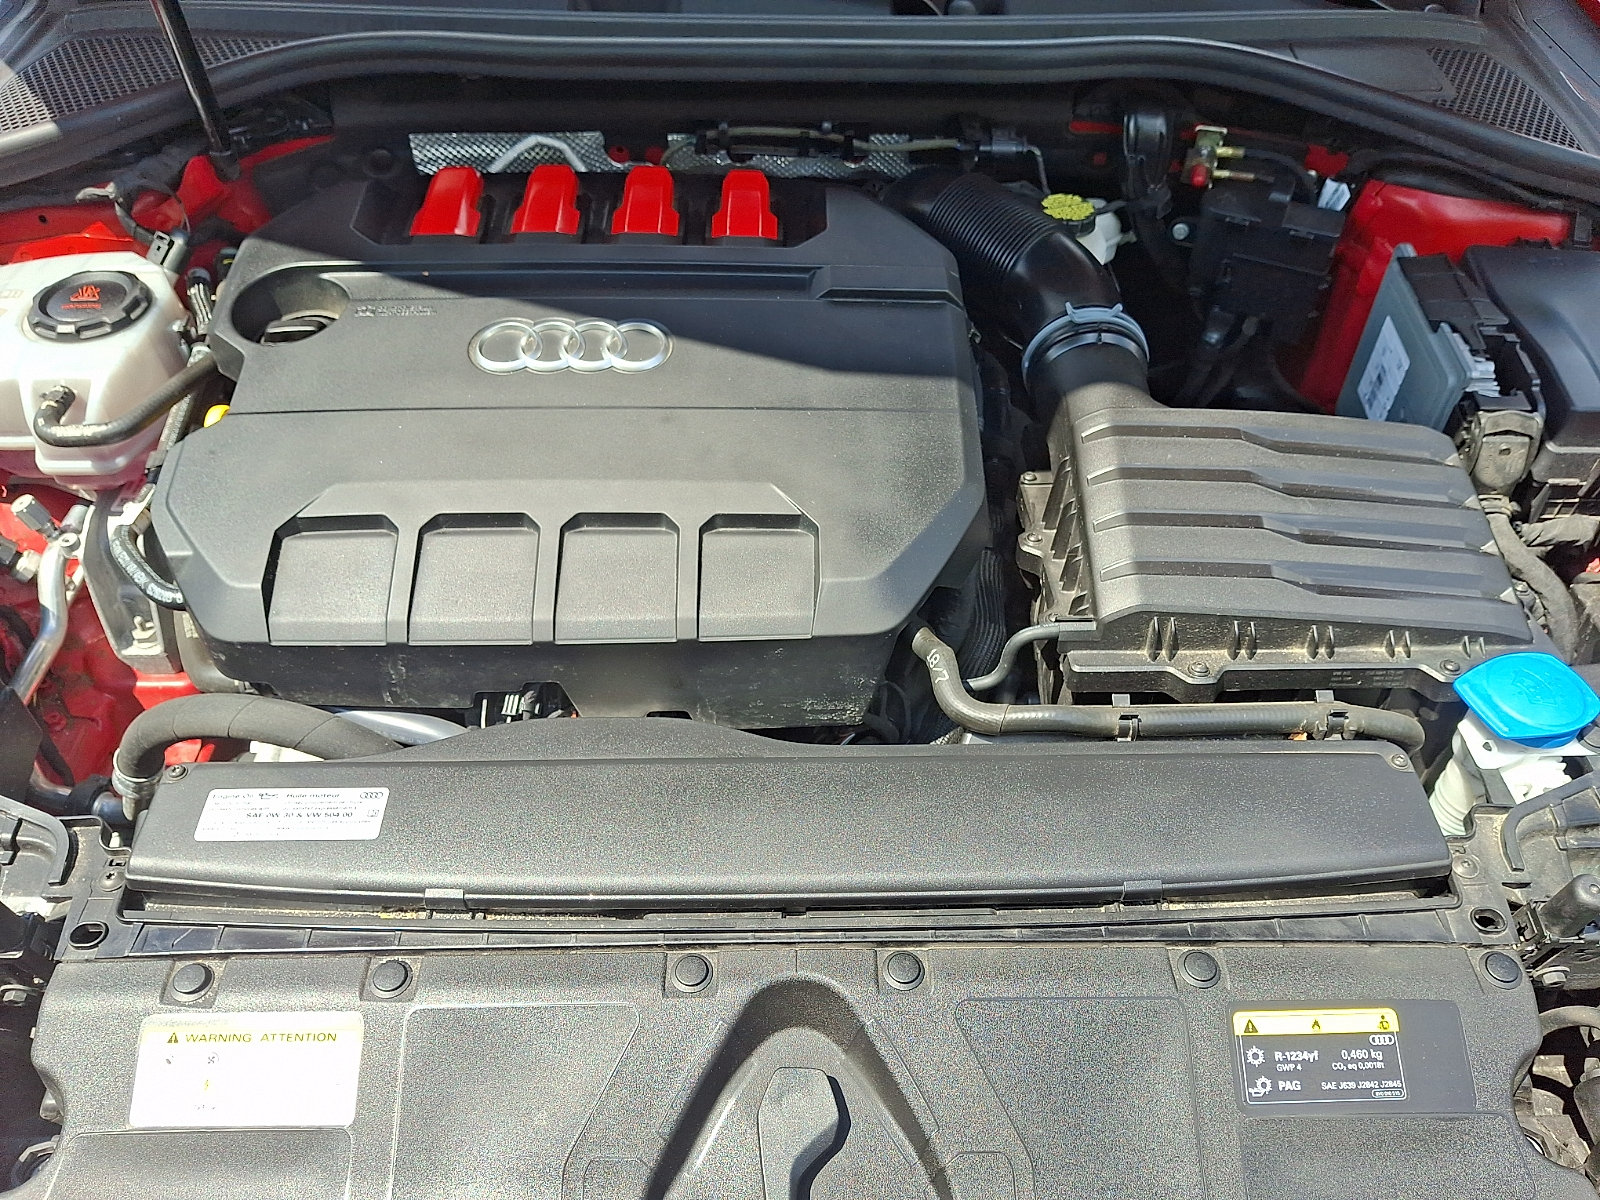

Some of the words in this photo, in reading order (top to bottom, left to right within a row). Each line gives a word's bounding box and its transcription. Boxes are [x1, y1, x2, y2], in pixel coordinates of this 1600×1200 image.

[185, 1033, 252, 1043] WARNING
[260, 1032, 338, 1043] ATTENTION
[1274, 1050, 1319, 1063] R-1234yf
[1341, 1050, 1369, 1061] 0,460
[1370, 1049, 1383, 1061] kg
[1276, 1064, 1295, 1072] GWP
[1348, 1063, 1358, 1071] eq
[1278, 1081, 1301, 1091] PAG
[1321, 1082, 1337, 1090] SAE
[1338, 1082, 1356, 1090] J639
[1357, 1081, 1379, 1089] J2842
[1380, 1080, 1402, 1088] J2845
